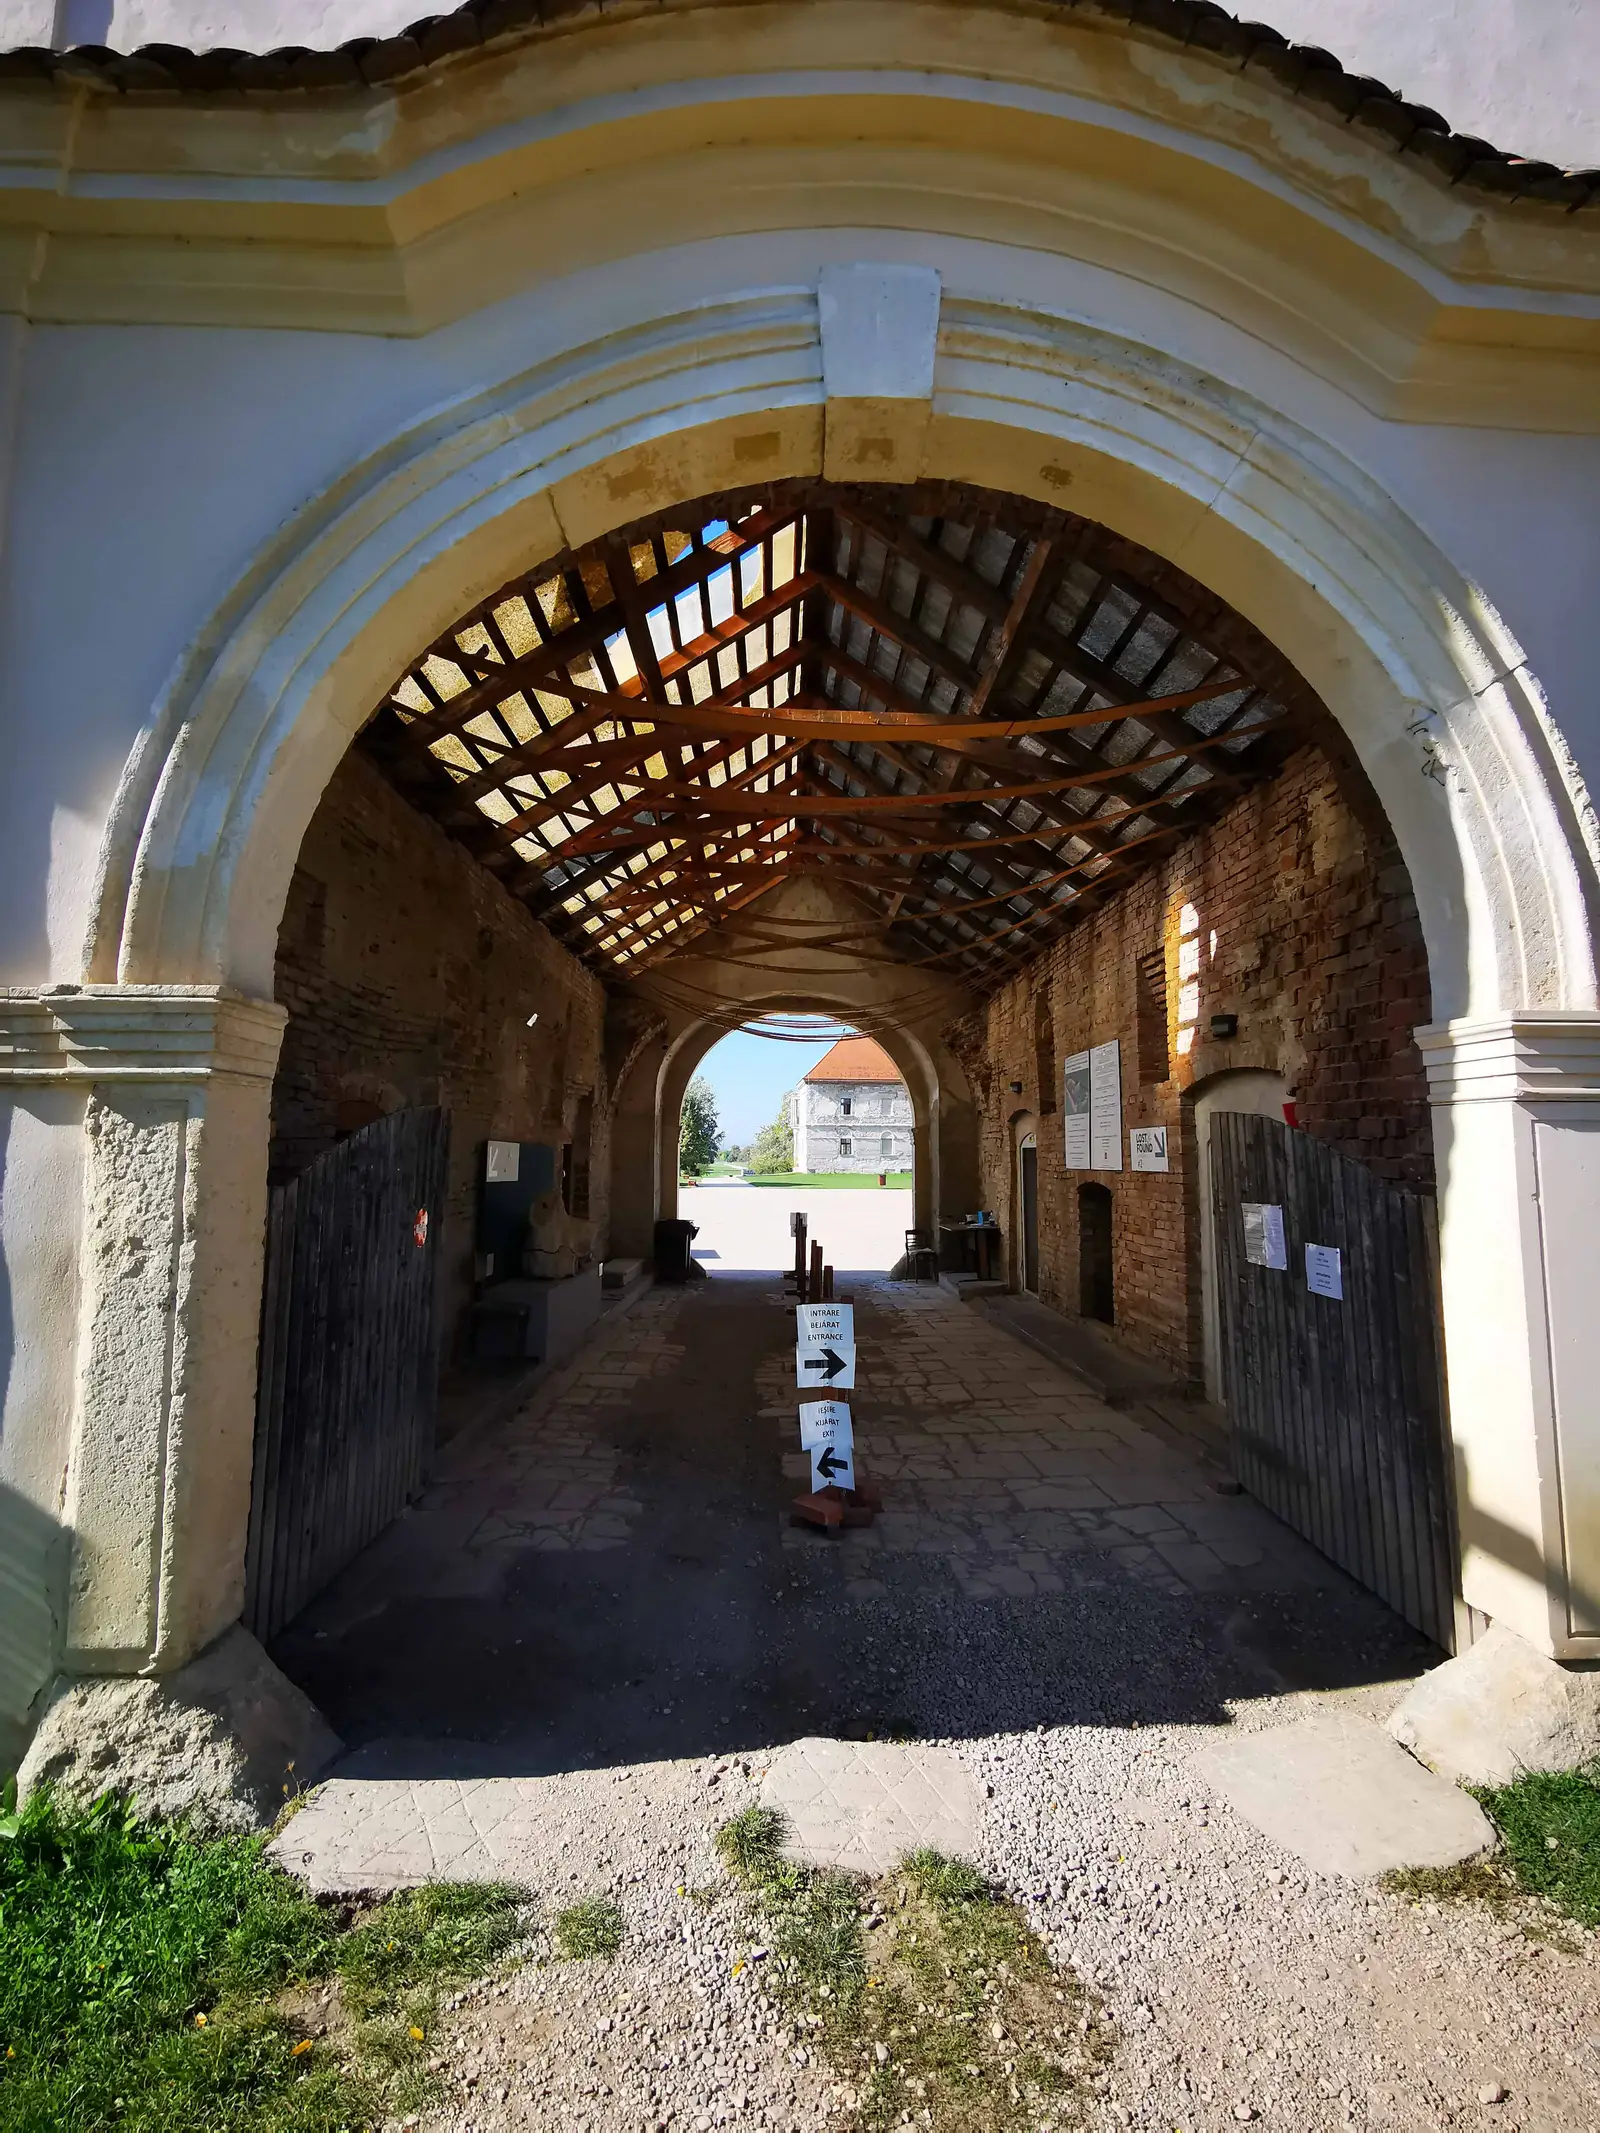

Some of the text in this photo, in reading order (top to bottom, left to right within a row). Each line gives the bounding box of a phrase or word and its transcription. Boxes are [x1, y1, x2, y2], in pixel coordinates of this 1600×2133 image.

[1136, 1133, 1147, 1143] LOST
[1136, 1143, 1153, 1154] FOUND
[810, 1309, 840, 1317] INTRARE
[810, 1320, 840, 1328] BEJÁRAT
[808, 1333, 844, 1341] ENTRANCE
[815, 1417, 840, 1427] KIJÁRAT
[822, 1430, 835, 1438] EXIT
